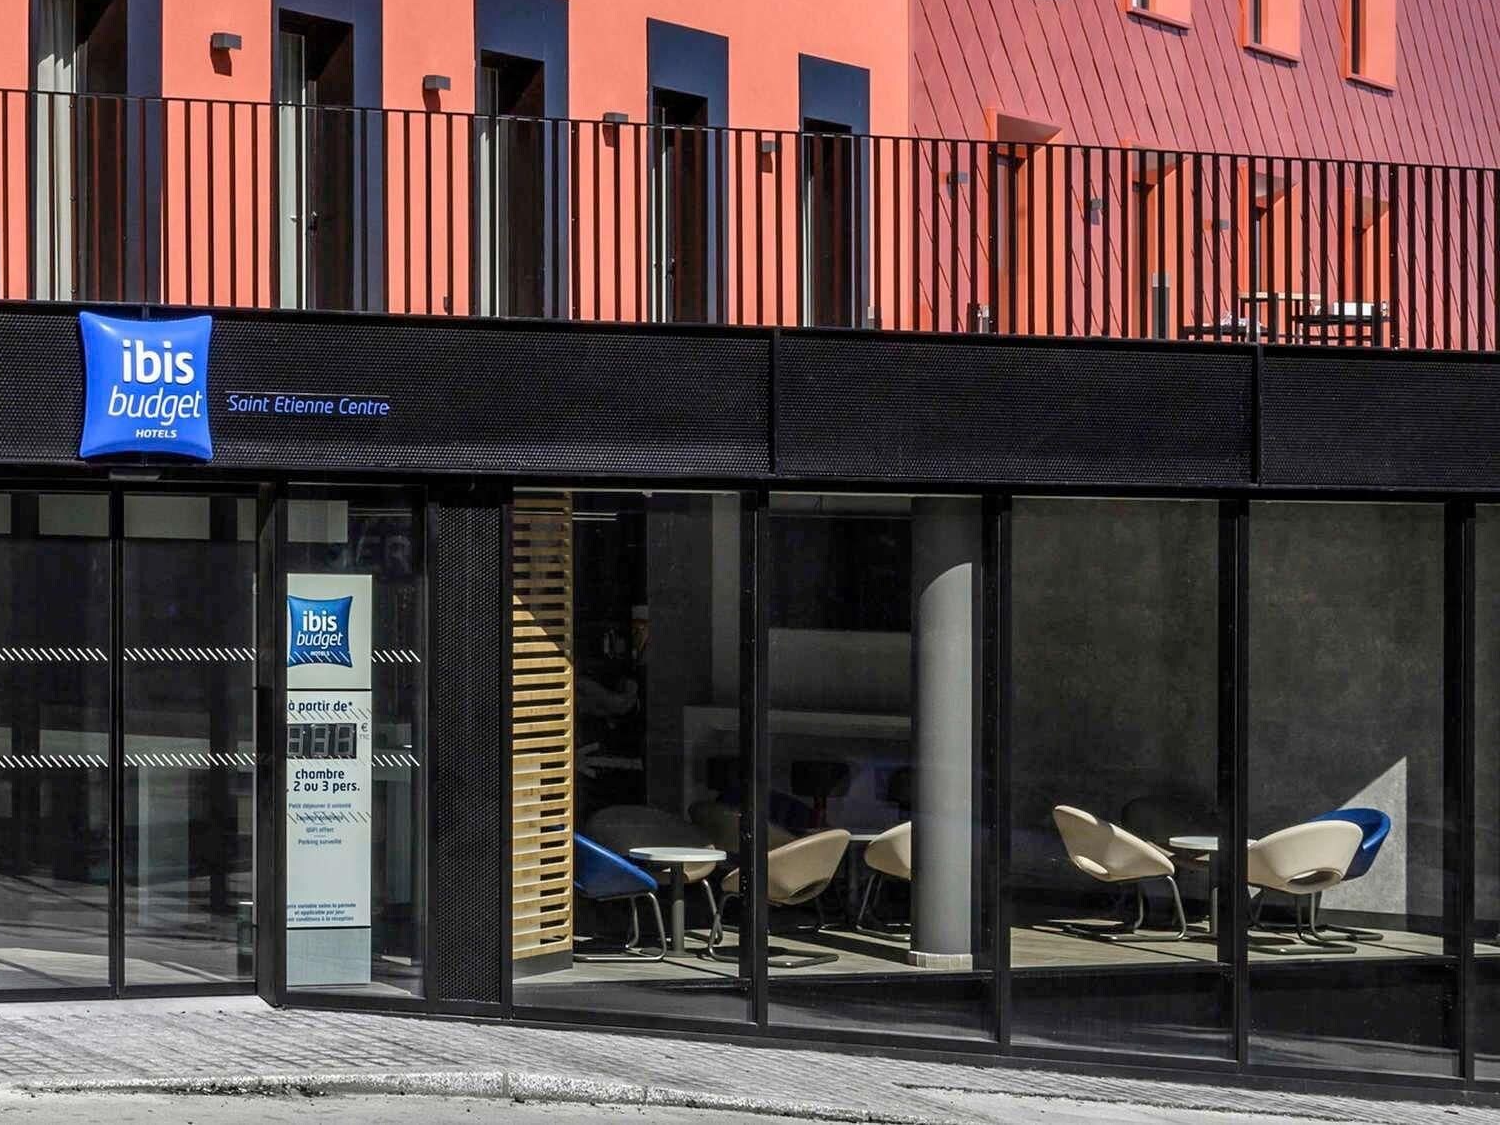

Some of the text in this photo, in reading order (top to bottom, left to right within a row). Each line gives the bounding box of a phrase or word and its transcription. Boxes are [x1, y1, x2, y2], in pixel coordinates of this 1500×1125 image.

[122, 339, 195, 384] ibis
[108, 385, 203, 426] budget
[228, 394, 389, 415] Saint Etienne Centre
[135, 428, 178, 438] HOTELS
[302, 610, 338, 632] ibis
[296, 631, 343, 649] budget
[298, 700, 331, 714] partir
[295, 767, 345, 779] chambre
[293, 780, 361, 794] 2 ou 3 pers.
